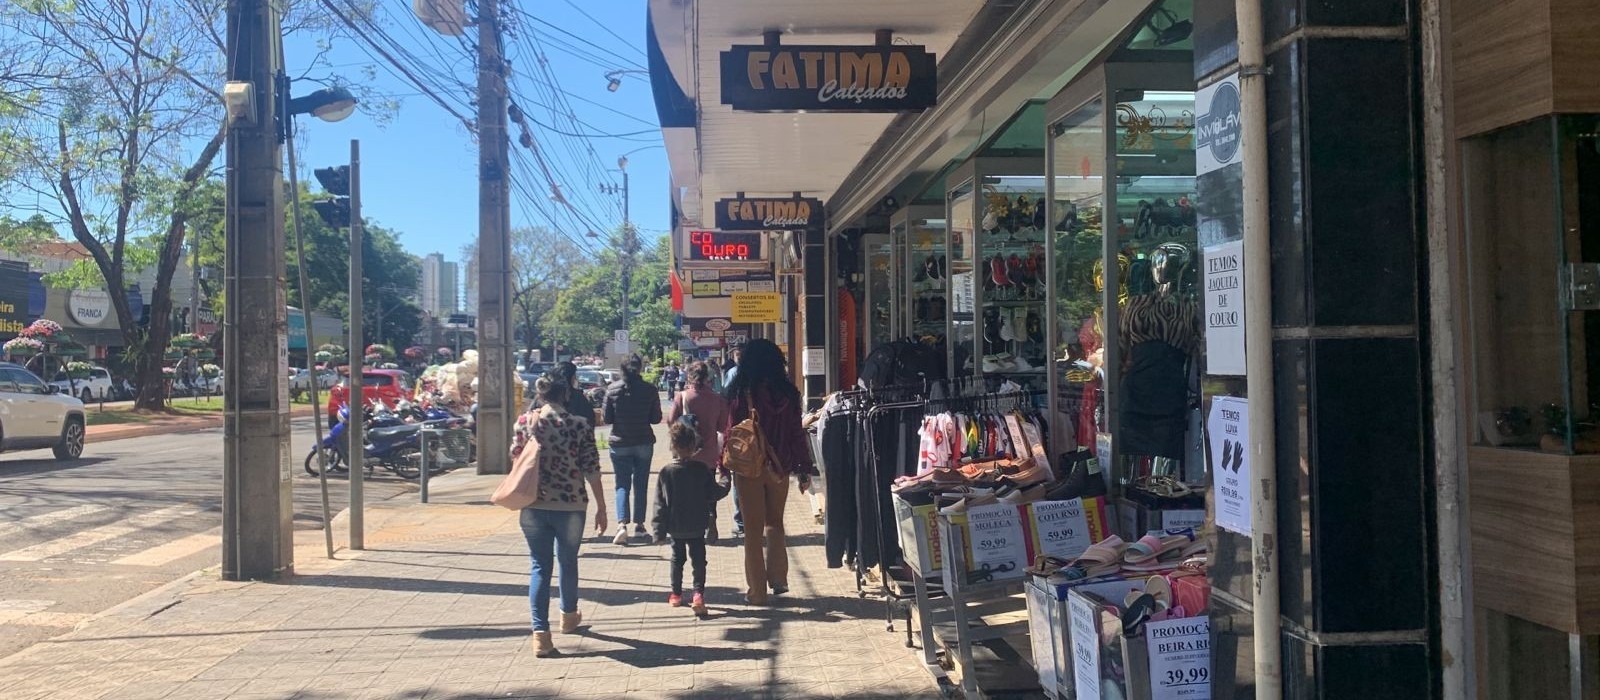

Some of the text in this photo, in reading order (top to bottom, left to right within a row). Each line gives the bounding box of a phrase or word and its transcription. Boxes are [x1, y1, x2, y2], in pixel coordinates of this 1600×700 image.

[747, 51, 910, 90] FATIMA
[818, 78, 907, 104] Calçados
[728, 200, 811, 221] FATIMA
[1208, 254, 1238, 272] TEMOS
[0, 301, 14, 313] ira
[1218, 294, 1228, 305] DE
[1209, 311, 1238, 326] COURO
[1048, 529, 1073, 541] 59,99
[981, 538, 1006, 551] 59,99
[1158, 642, 1193, 652] BEIRA
[1167, 667, 1208, 685] 39,99
